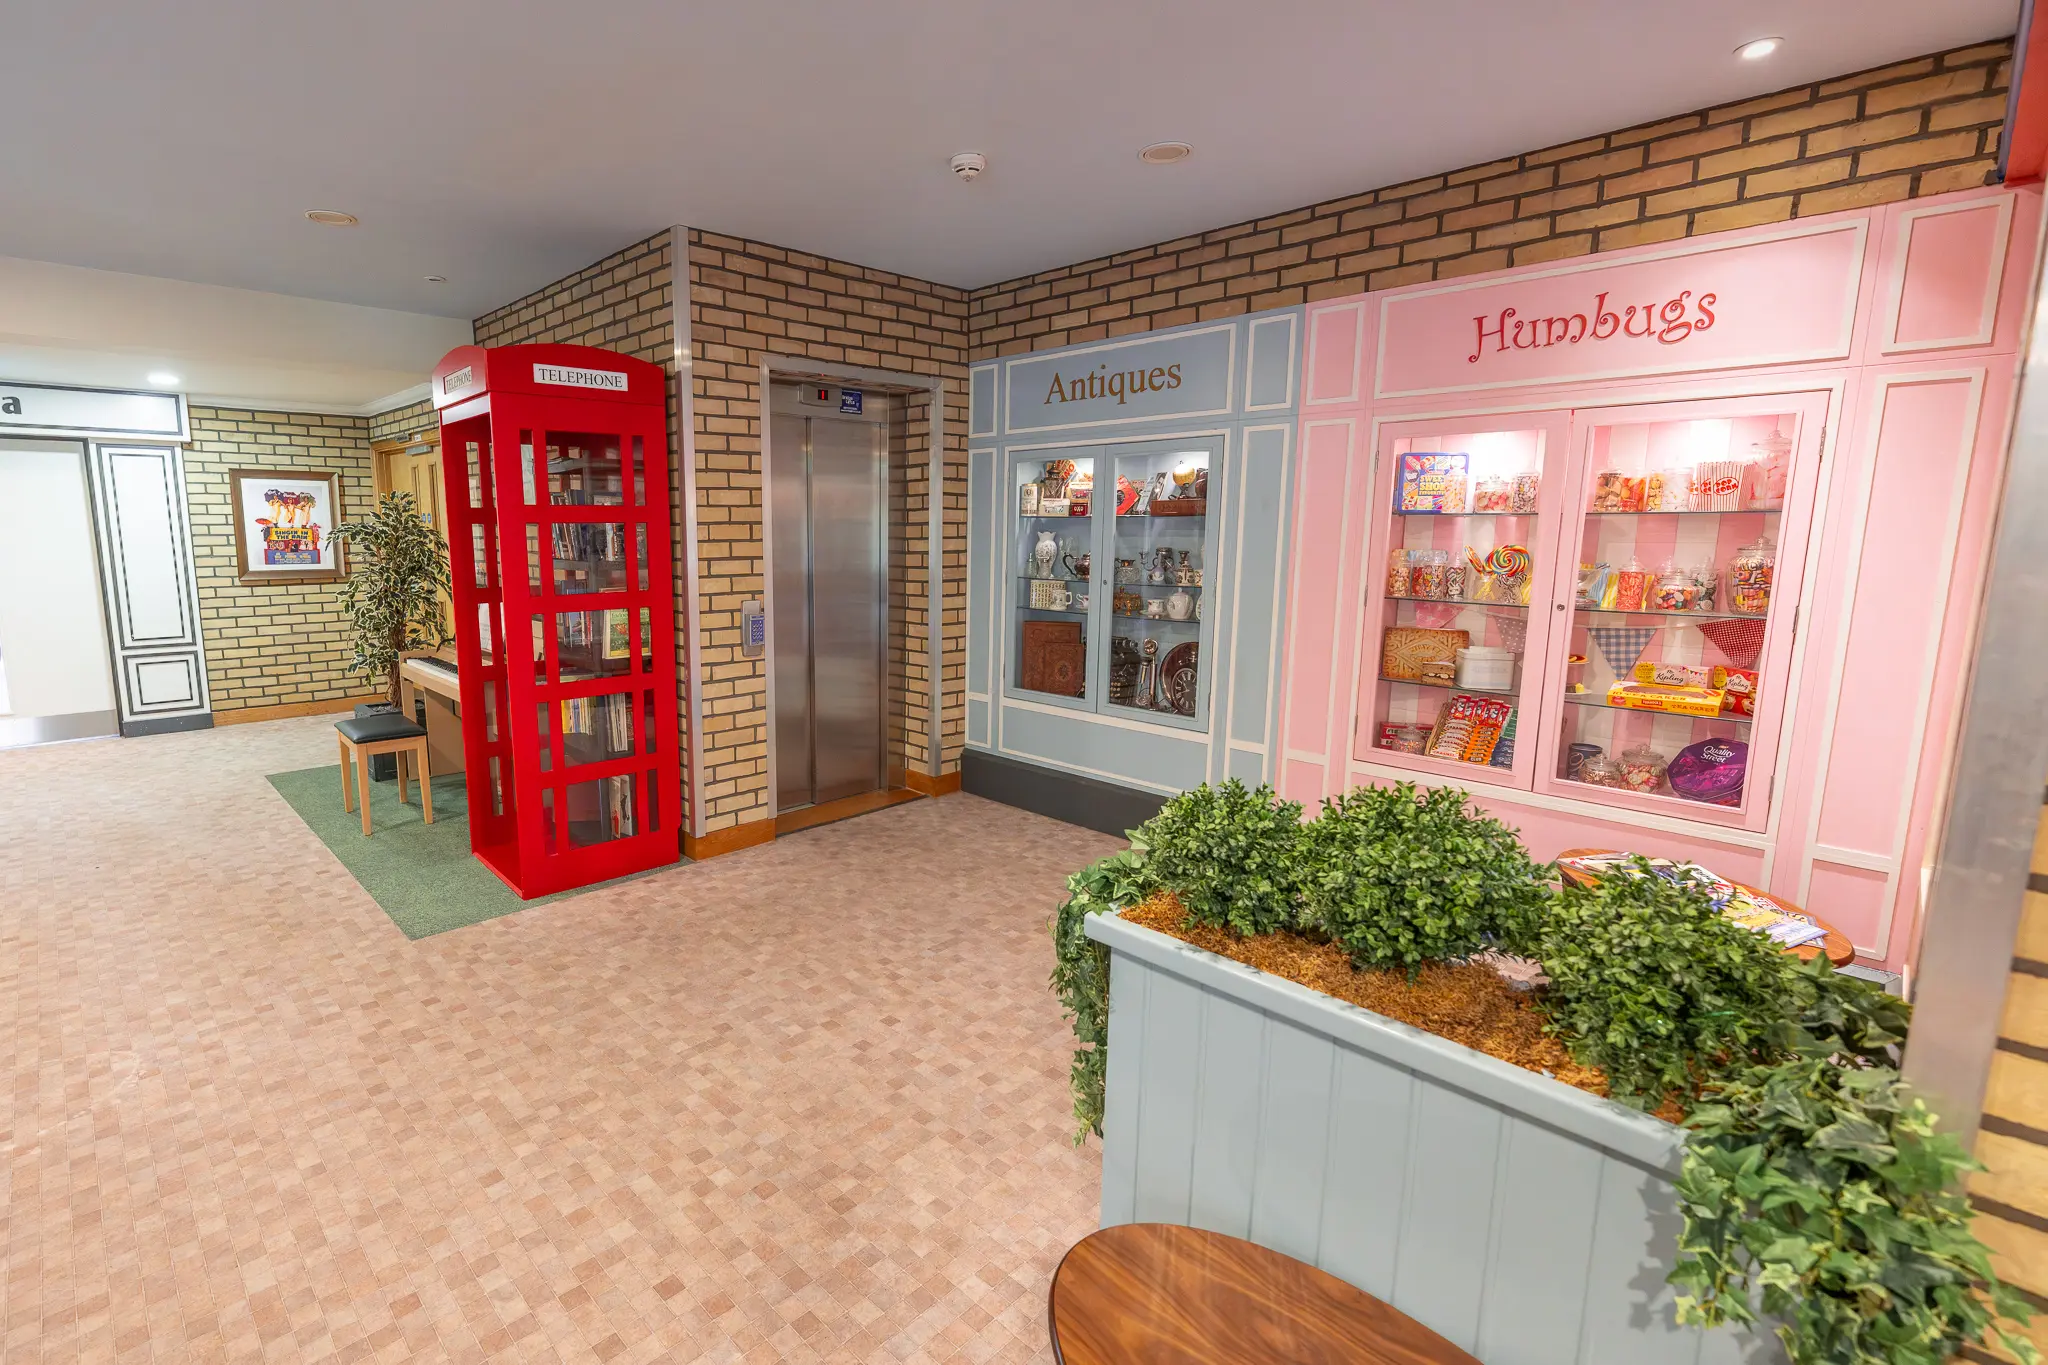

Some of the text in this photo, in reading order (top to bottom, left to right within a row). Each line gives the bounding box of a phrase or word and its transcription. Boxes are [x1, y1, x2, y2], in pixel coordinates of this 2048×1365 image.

[1468, 290, 1717, 363] Humbugs
[446, 370, 471, 389] TELEPHONE
[538, 368, 623, 388] TELEPHONE
[1043, 363, 1182, 406] Antiques
[2, 396, 22, 415] a
[1715, 479, 1732, 488] POP
[1715, 483, 1739, 494] CORN
[1655, 672, 1684, 684] Kipling
[1728, 679, 1749, 691] Kipling
[1700, 752, 1727, 763] Street
[1704, 746, 1735, 758] Quality
